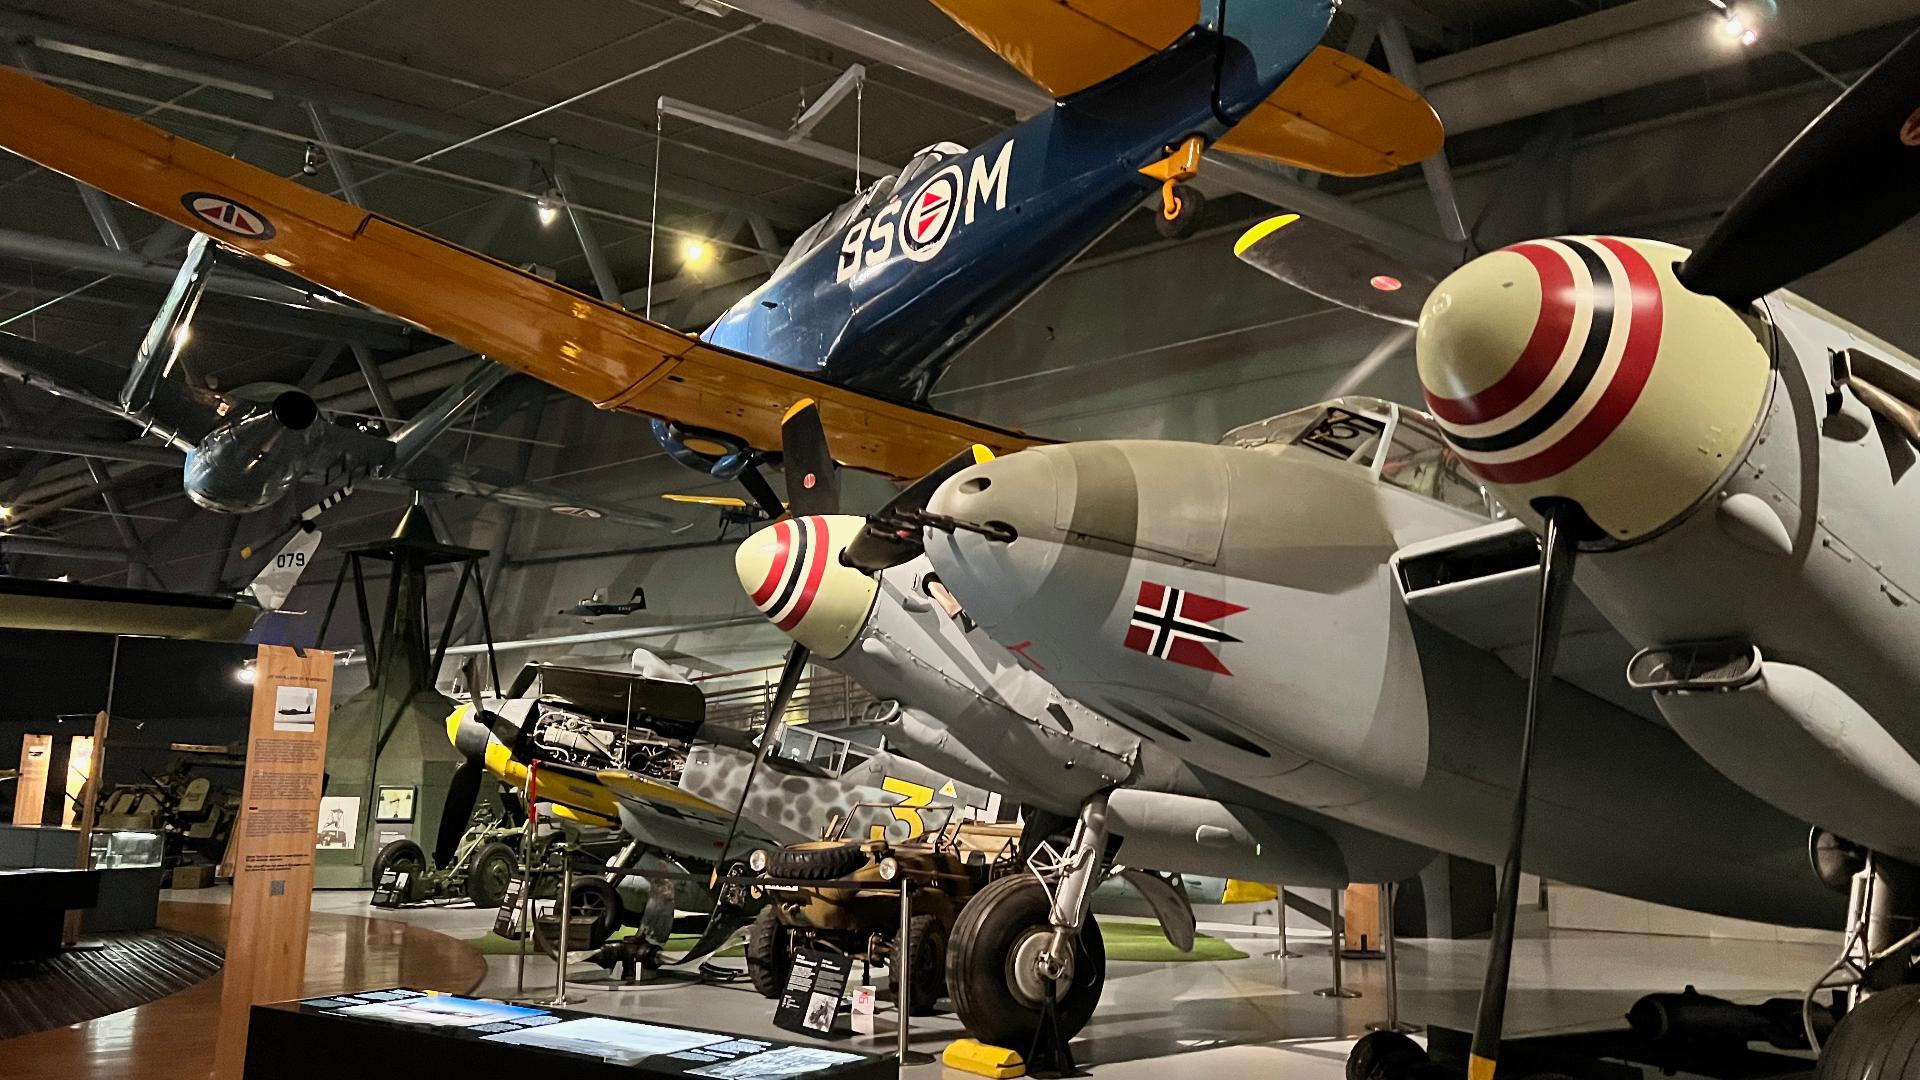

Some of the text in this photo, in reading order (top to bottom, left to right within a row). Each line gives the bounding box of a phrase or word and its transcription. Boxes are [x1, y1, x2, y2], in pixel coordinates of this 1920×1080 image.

[965, 139, 1014, 225] M
[277, 552, 305, 568] 079
[869, 775, 935, 841] 3
